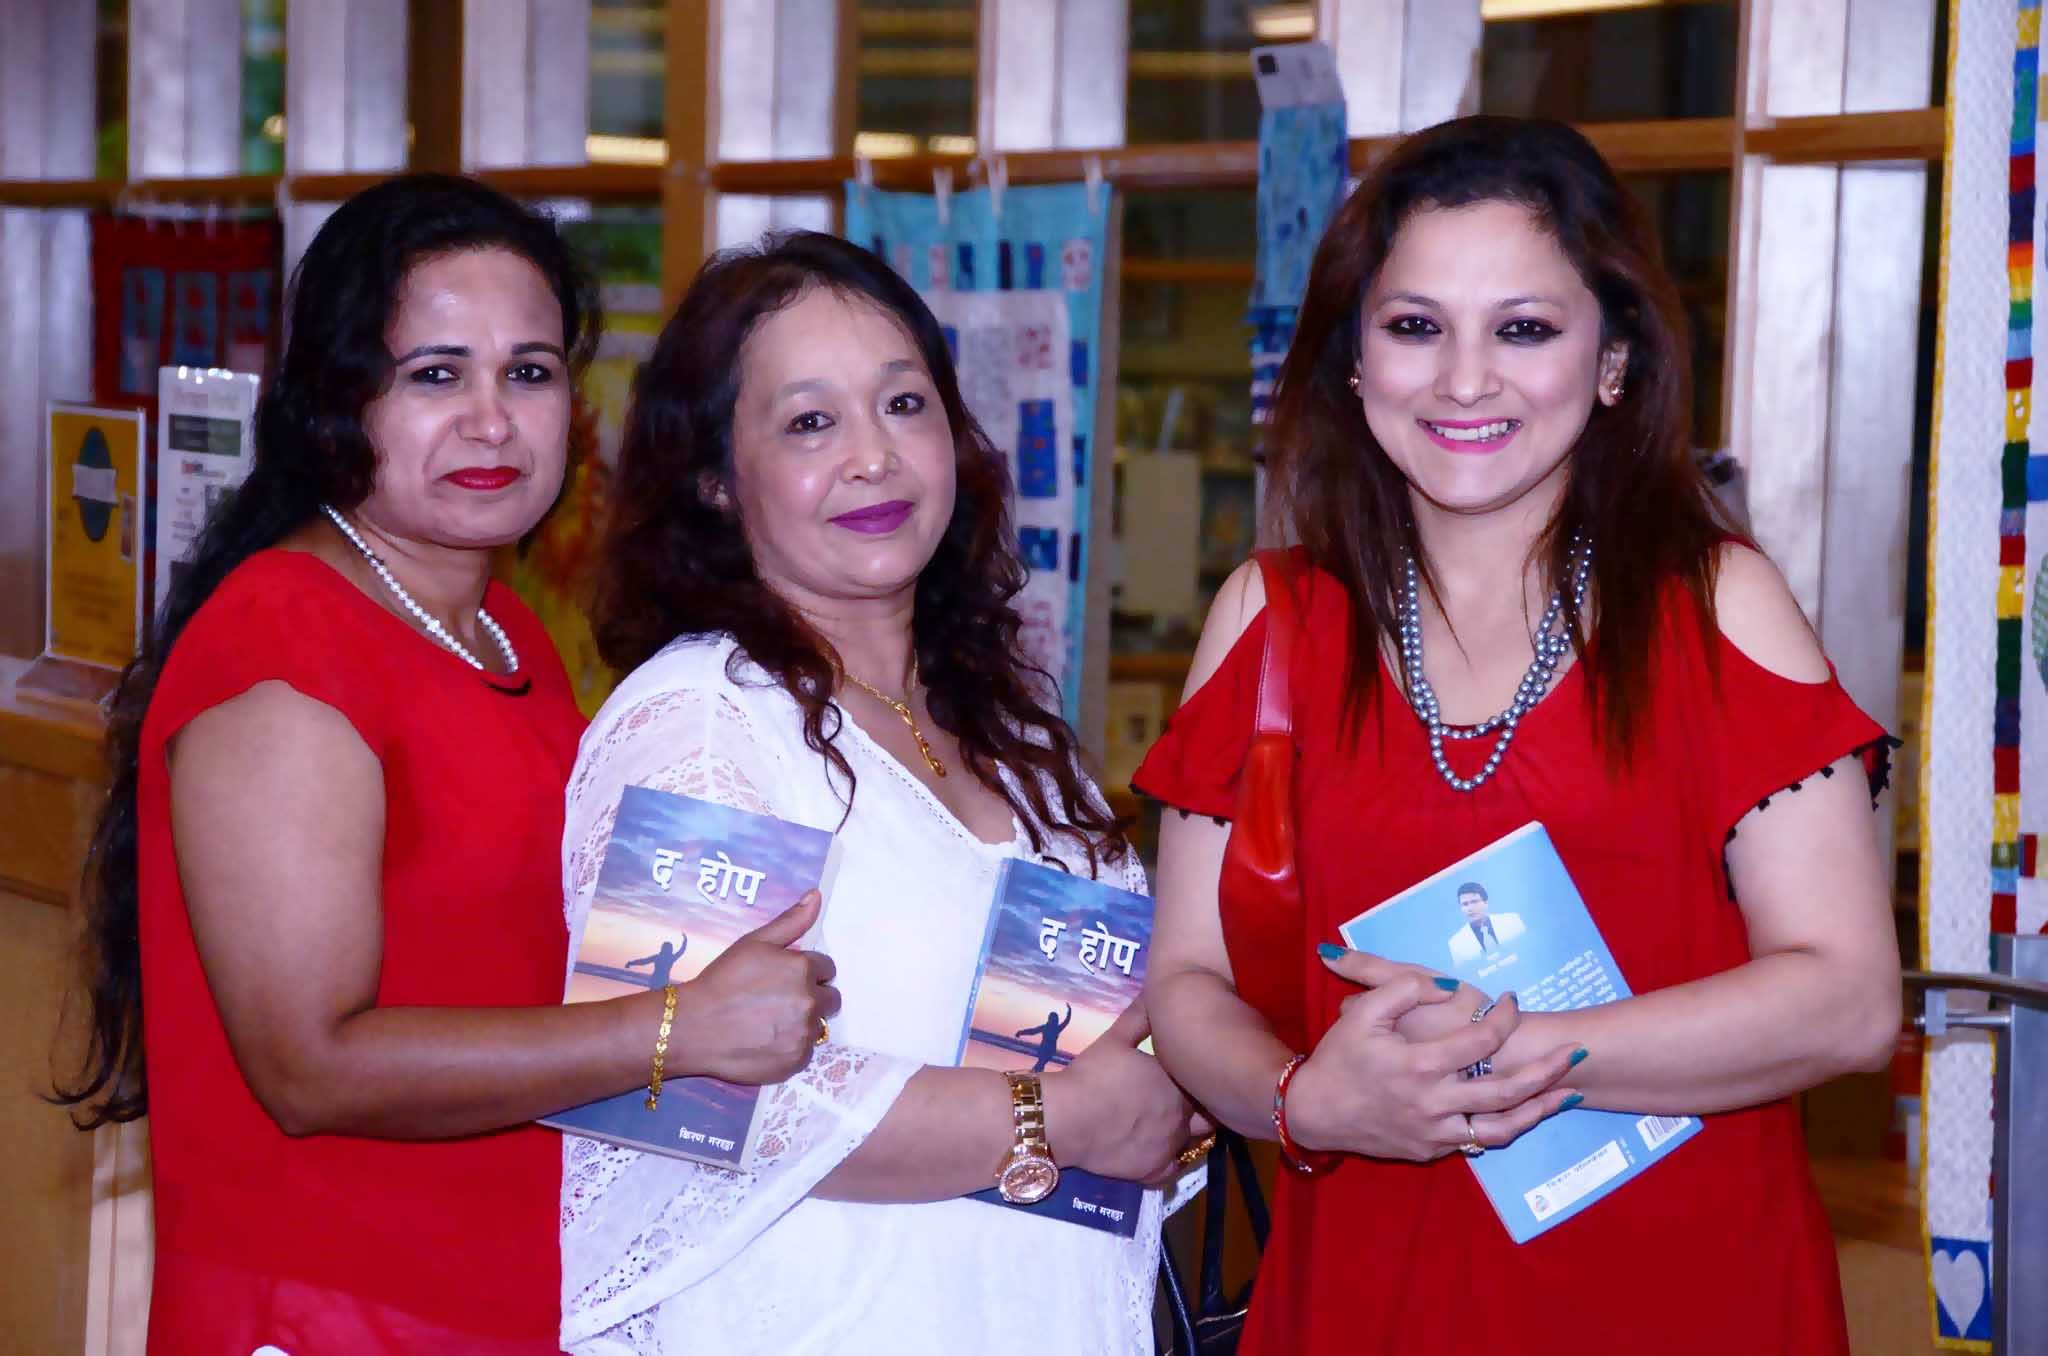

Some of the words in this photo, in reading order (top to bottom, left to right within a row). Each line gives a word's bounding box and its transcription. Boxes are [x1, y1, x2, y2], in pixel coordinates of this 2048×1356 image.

[652, 848, 684, 891] द
[697, 850, 768, 905] होप
[1040, 917, 1067, 961] द
[1079, 920, 1141, 976] होप
